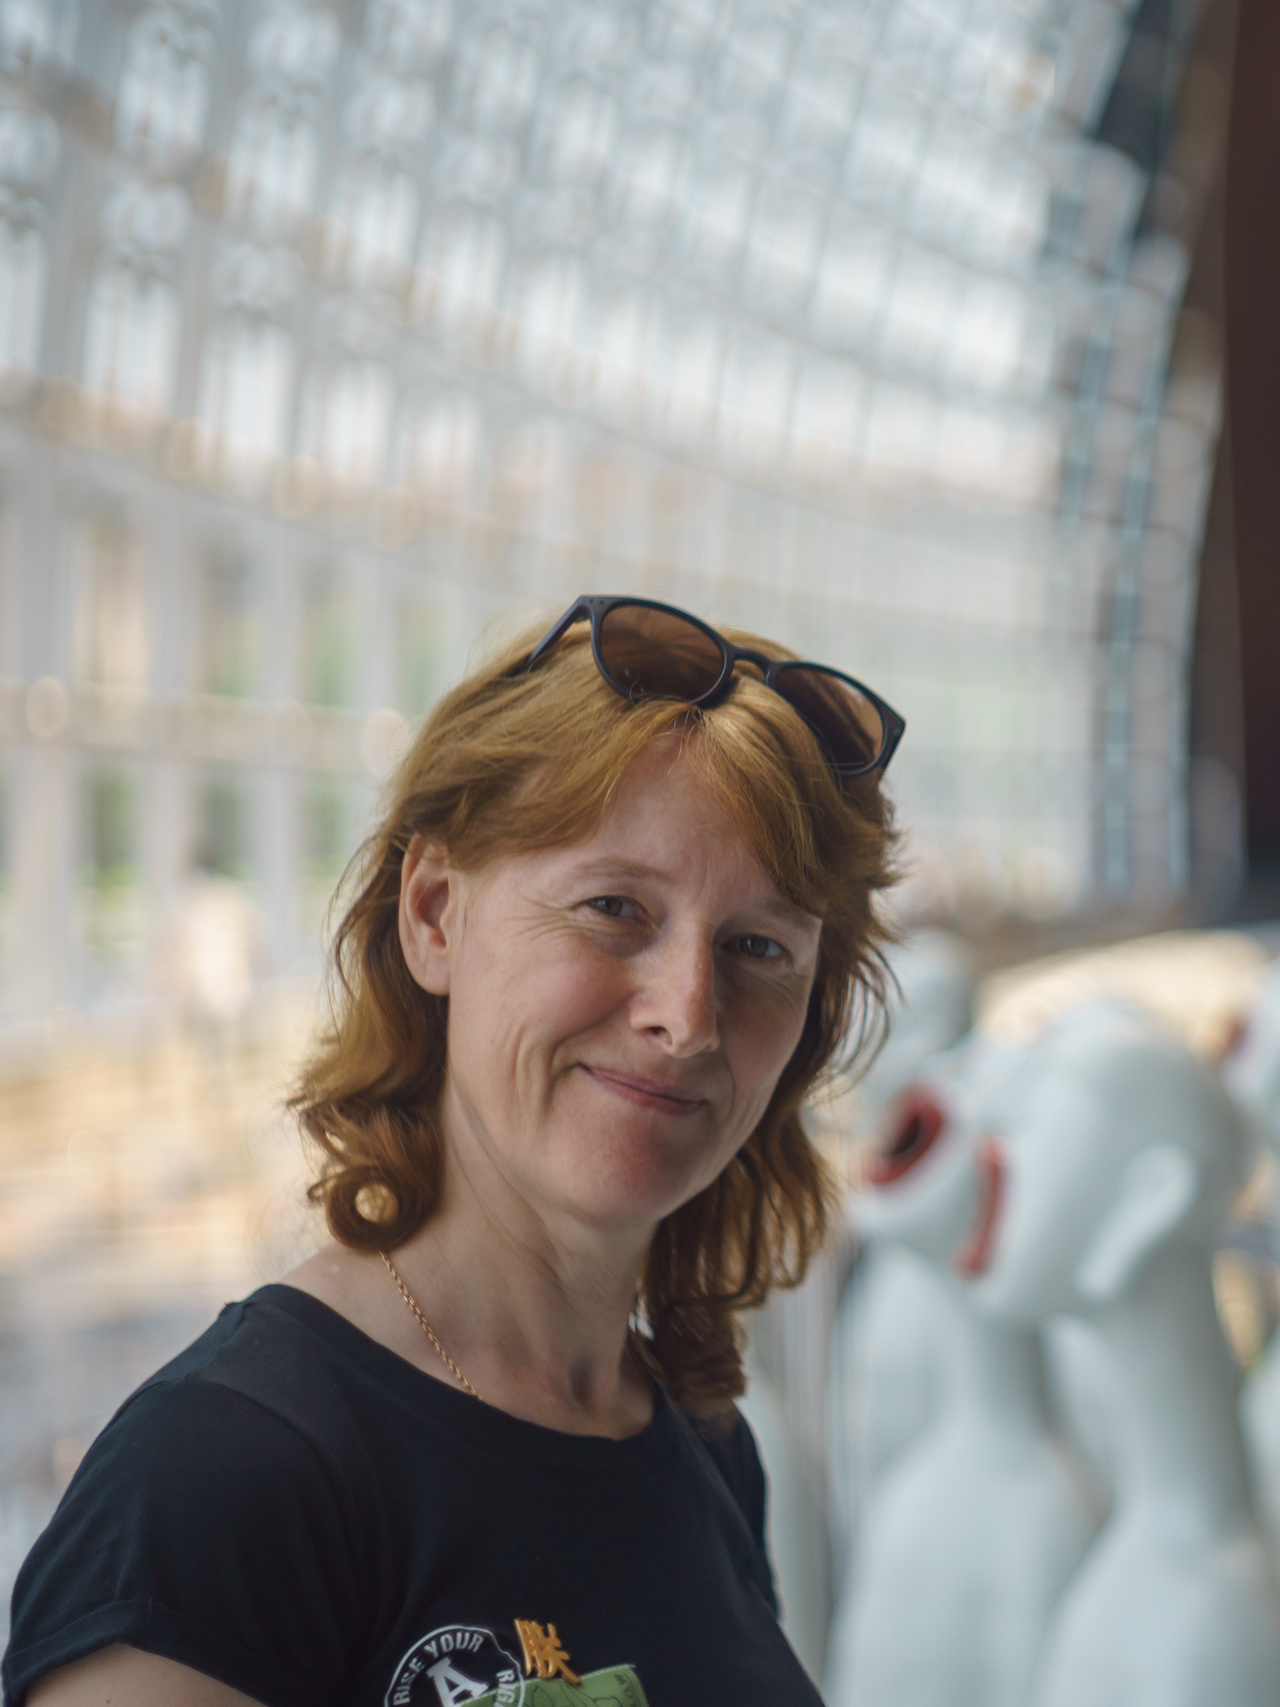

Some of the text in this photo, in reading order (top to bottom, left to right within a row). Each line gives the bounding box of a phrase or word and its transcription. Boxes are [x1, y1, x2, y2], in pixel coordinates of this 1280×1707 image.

[393, 1631, 516, 1707] RISE YOUR RIG
[426, 1656, 489, 1707] A
